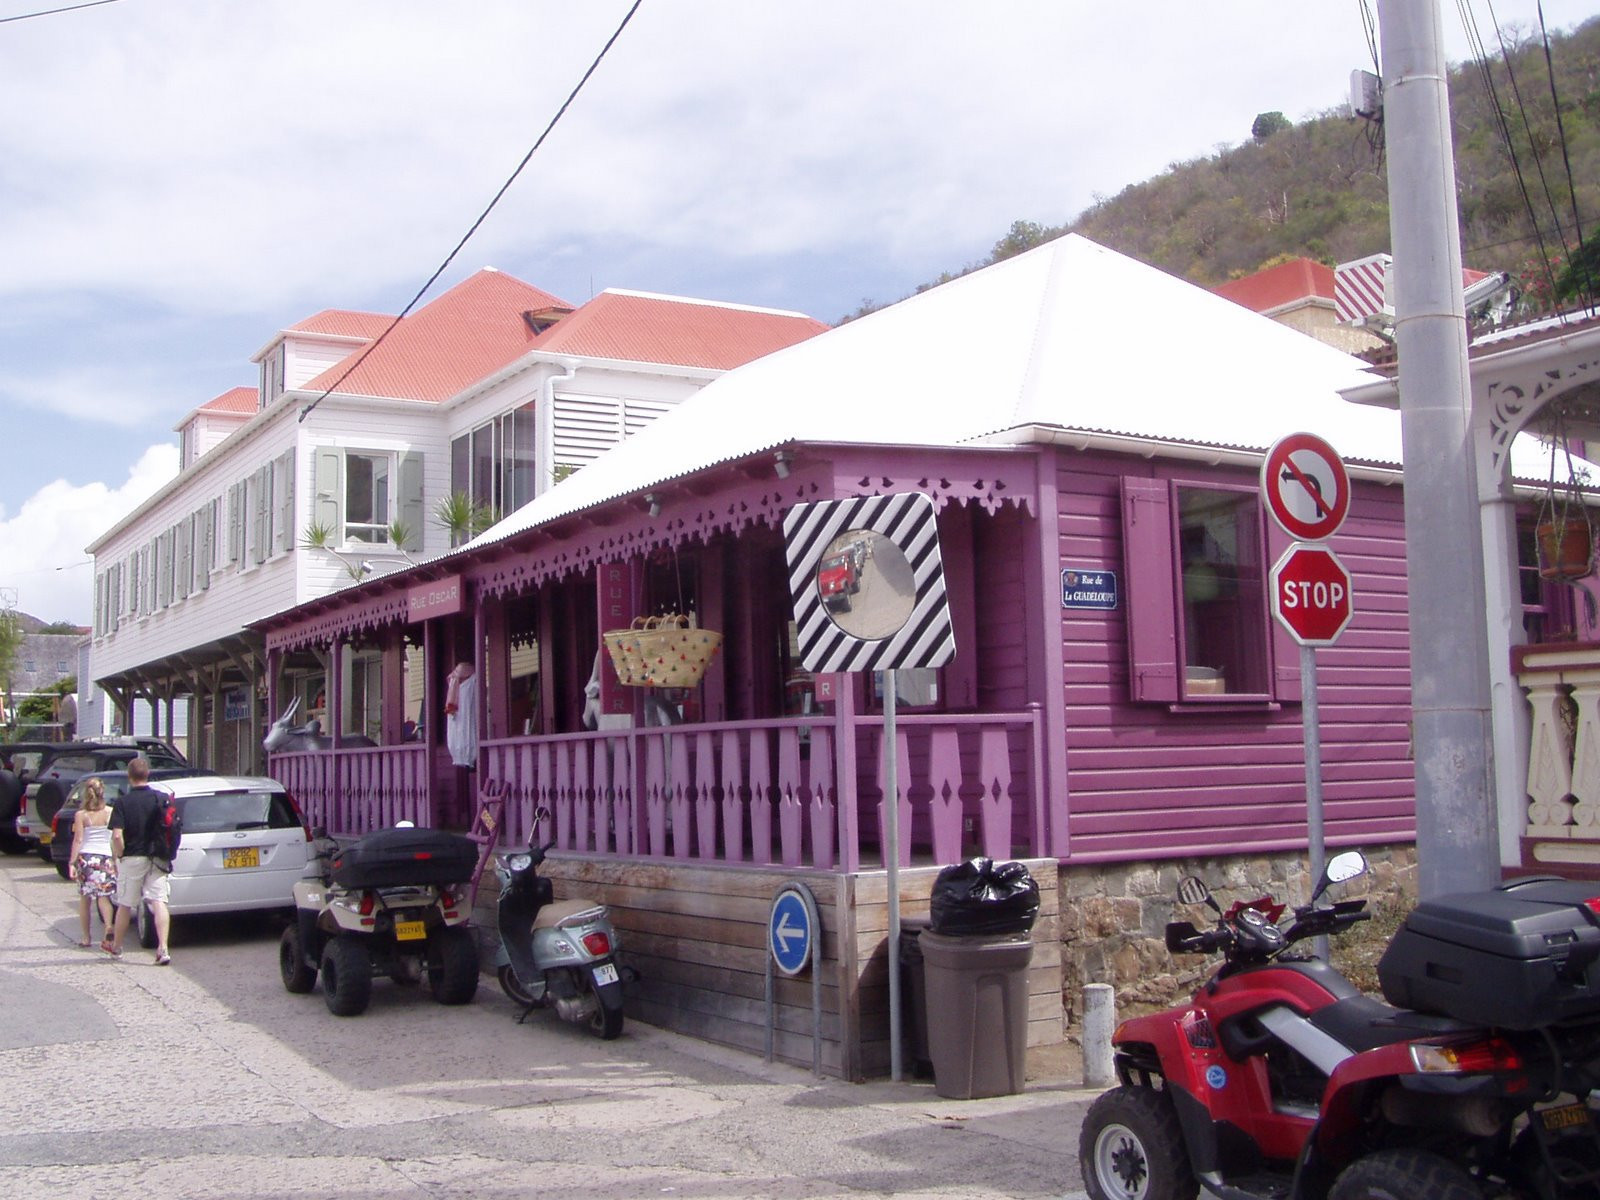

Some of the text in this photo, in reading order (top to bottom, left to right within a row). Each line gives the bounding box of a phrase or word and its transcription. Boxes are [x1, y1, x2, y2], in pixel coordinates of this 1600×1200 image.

[1081, 575, 1103, 585] Rue de
[411, 586, 457, 609] RUE OSCAR
[609, 570, 622, 616] RUE
[1073, 591, 1114, 602] GUADELOUPE
[1284, 580, 1344, 609] STOP
[241, 857, 257, 867] 971
